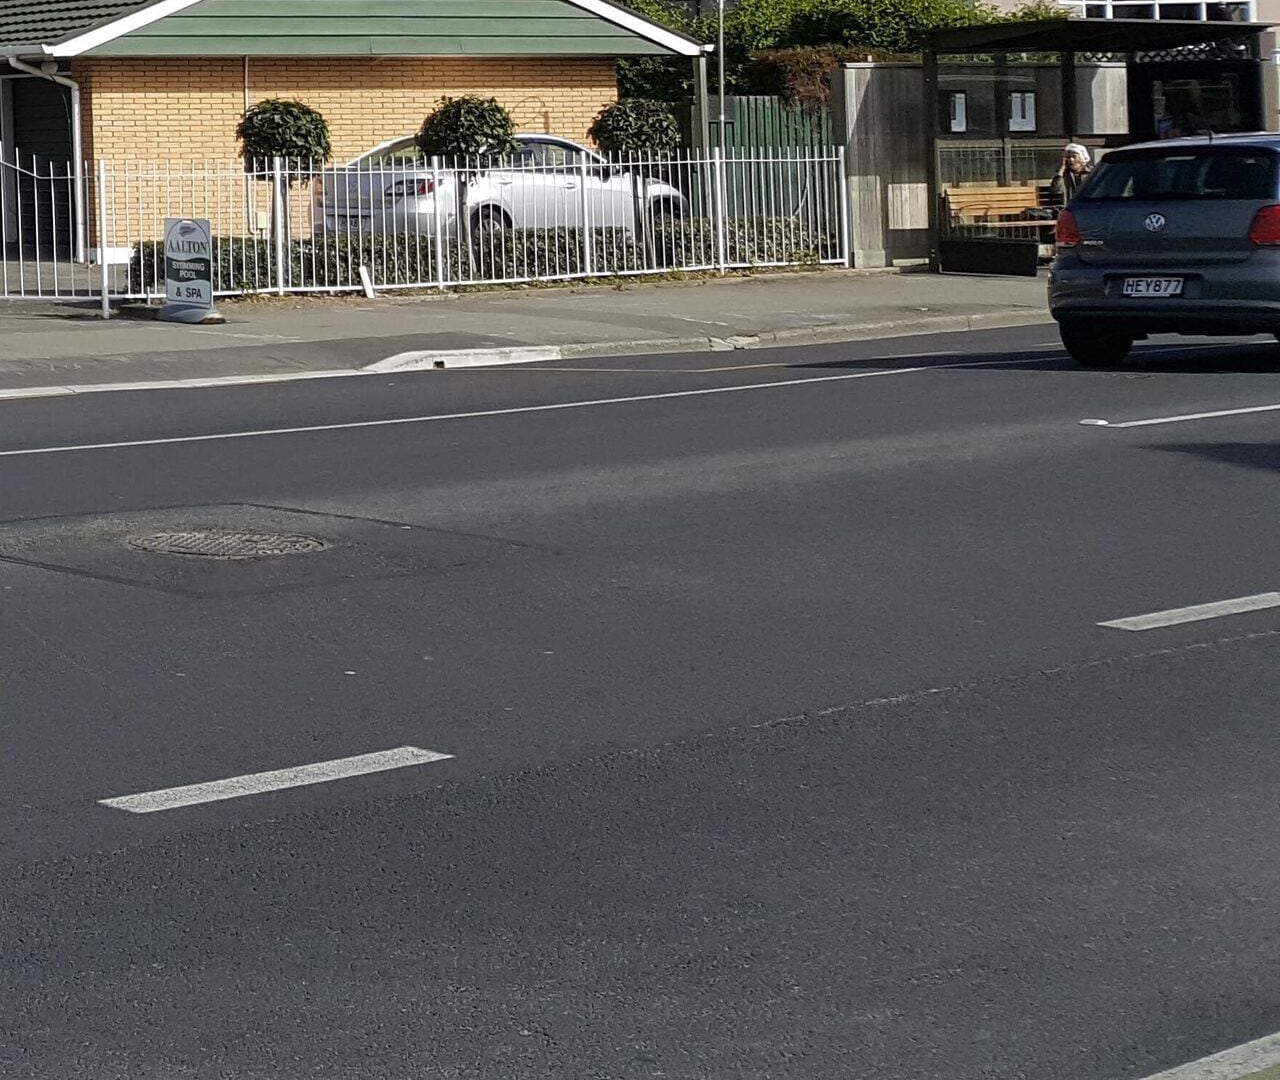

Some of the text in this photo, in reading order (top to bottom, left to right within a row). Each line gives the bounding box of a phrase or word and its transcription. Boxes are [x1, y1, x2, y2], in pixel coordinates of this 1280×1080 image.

[168, 240, 207, 254] AALTON
[180, 271, 197, 279] POOL
[175, 286, 202, 299] & SPA
[1125, 280, 1181, 293] HEY877
